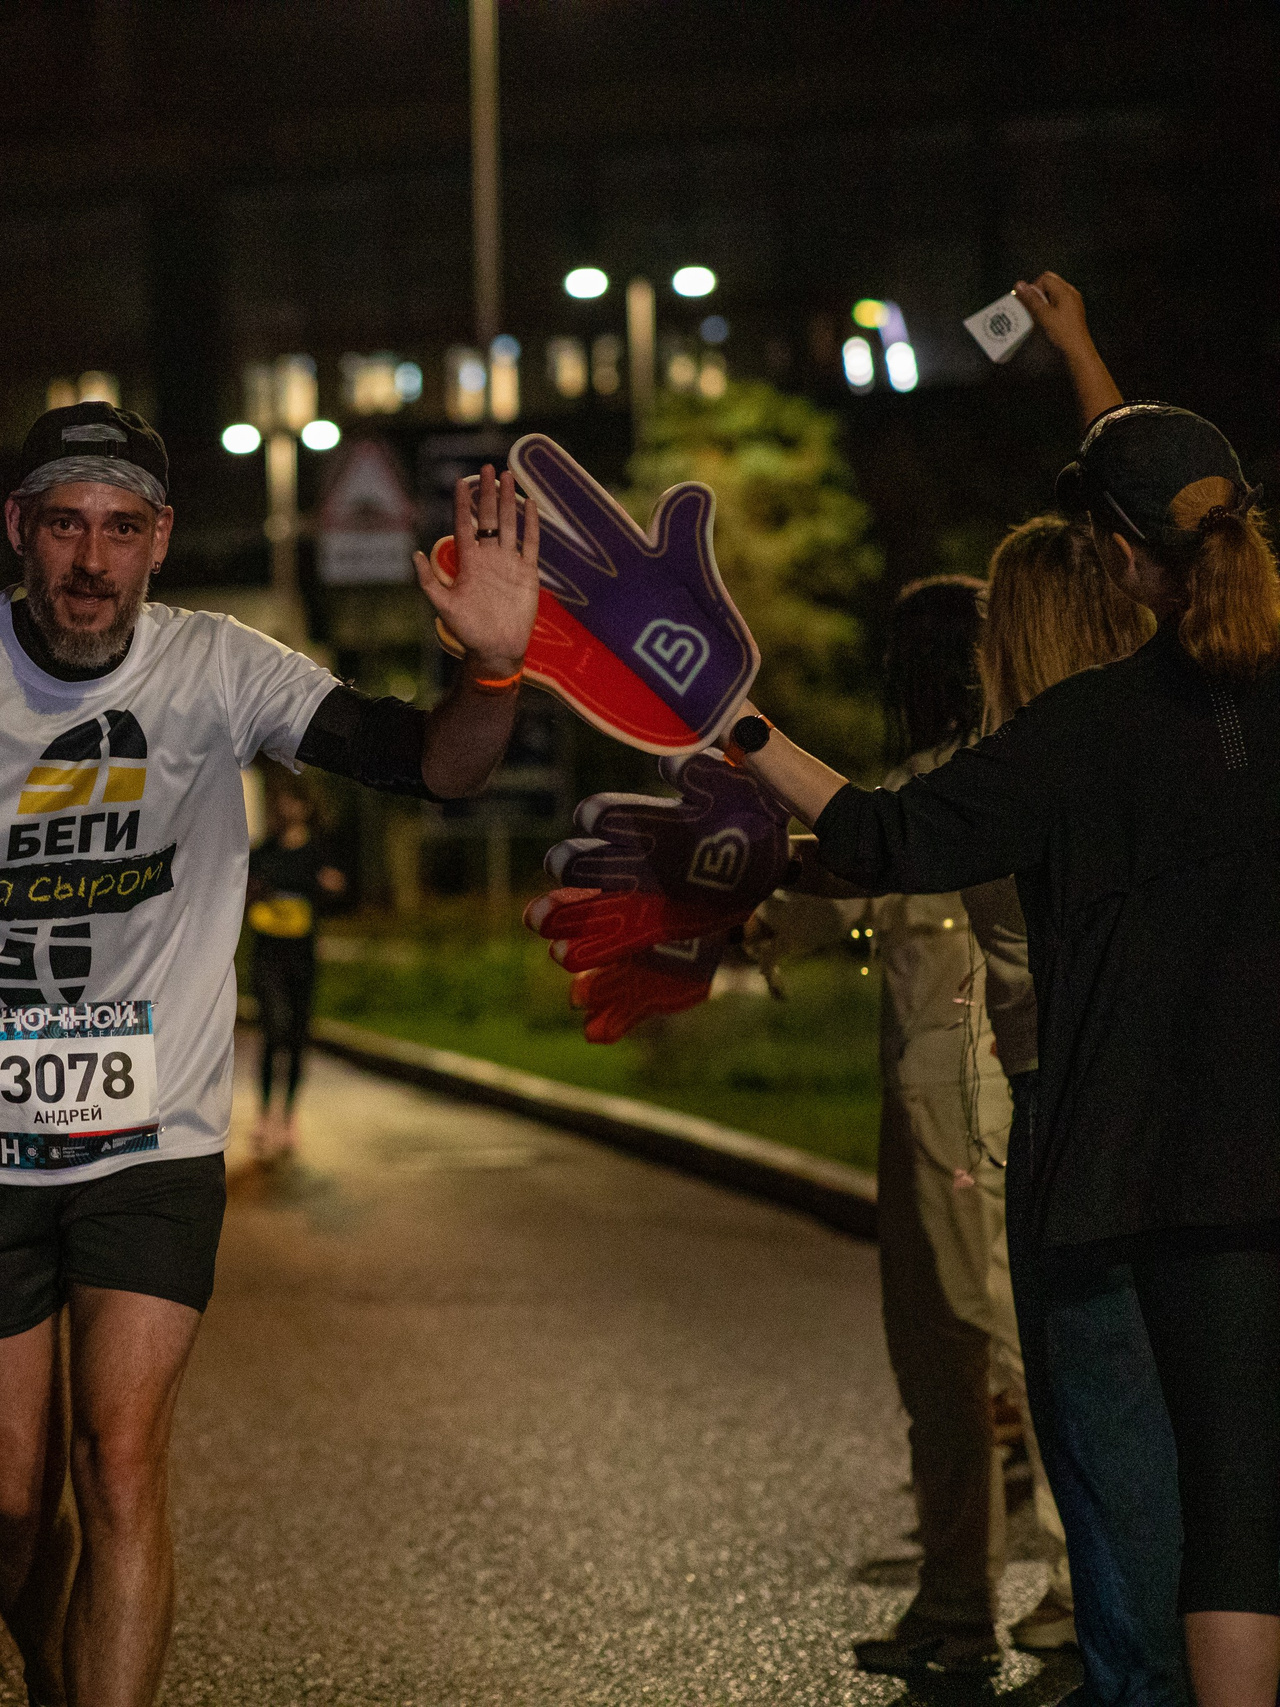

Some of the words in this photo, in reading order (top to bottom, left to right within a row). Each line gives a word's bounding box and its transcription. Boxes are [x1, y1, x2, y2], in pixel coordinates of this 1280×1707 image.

[6, 809, 140, 861] БЕГИ
[27, 861, 164, 908] сыром
[0, 1051, 135, 1104] 3078
[33, 1104, 103, 1126] АНДРЕЙ
